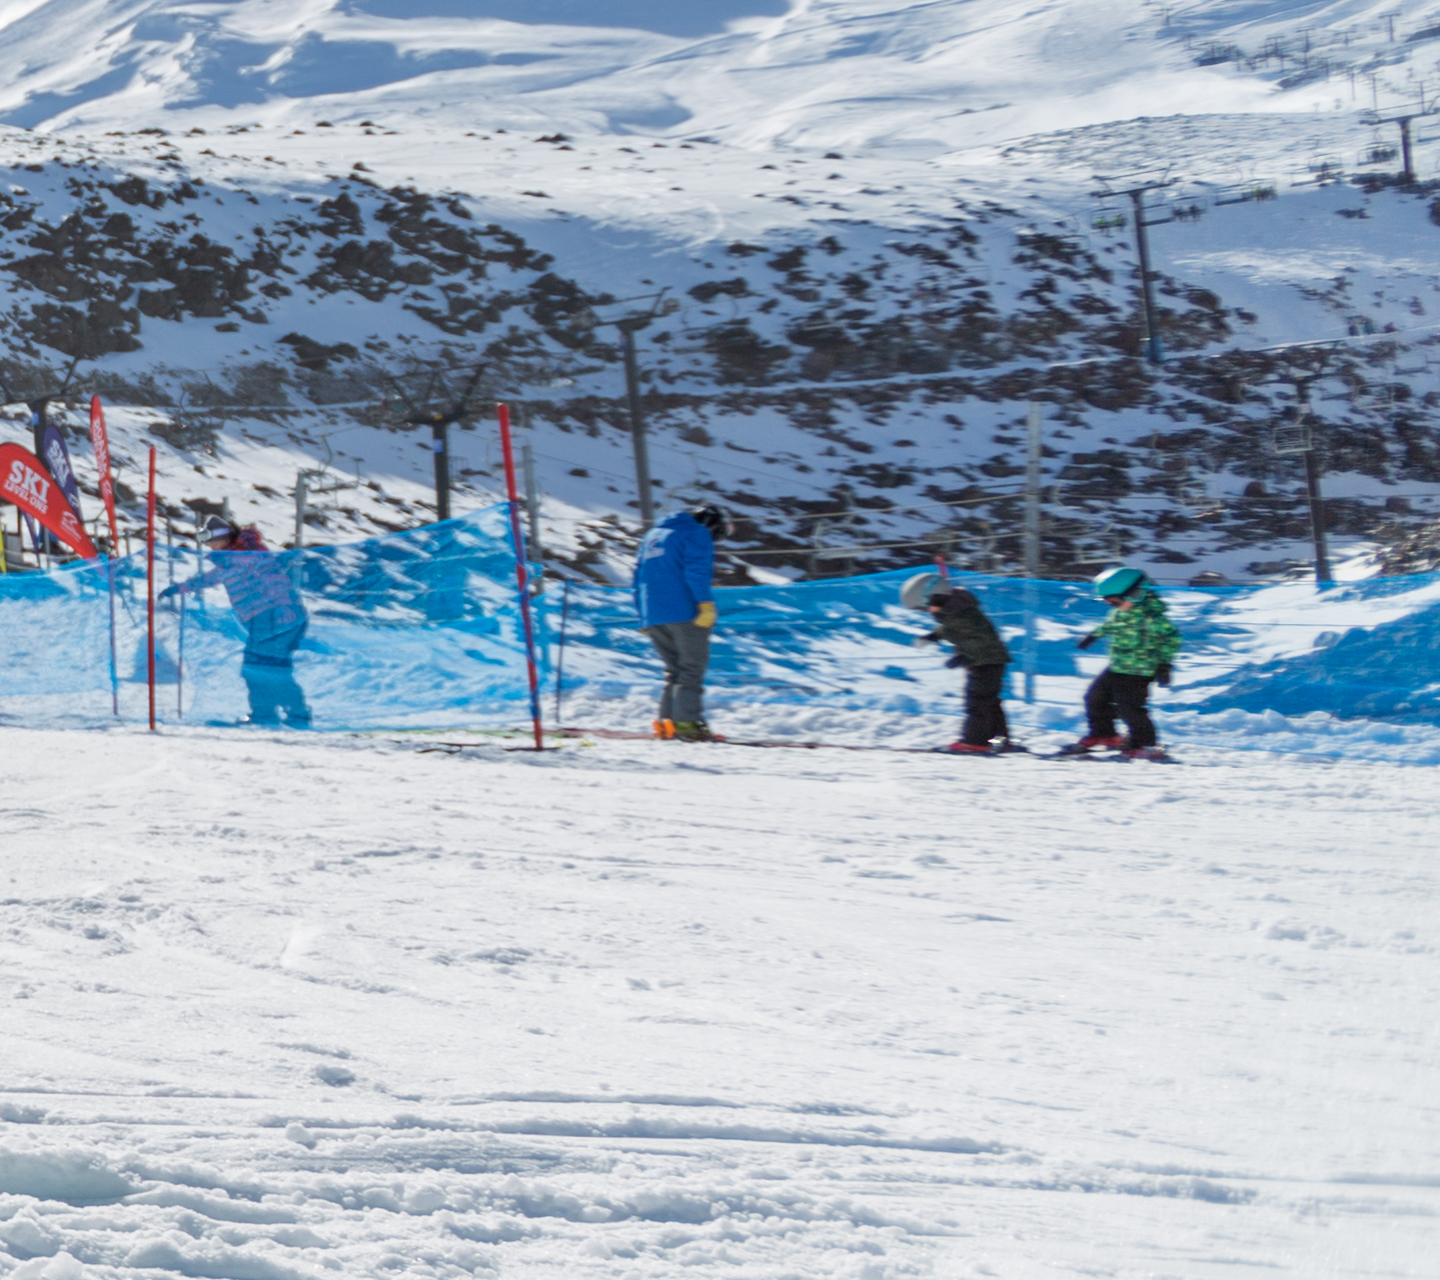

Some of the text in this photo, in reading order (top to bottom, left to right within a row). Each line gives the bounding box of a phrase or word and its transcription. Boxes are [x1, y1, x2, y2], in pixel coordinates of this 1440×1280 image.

[3, 478, 29, 501] LEVEL
[29, 495, 49, 515] ONE
[8, 460, 50, 504] SKI
